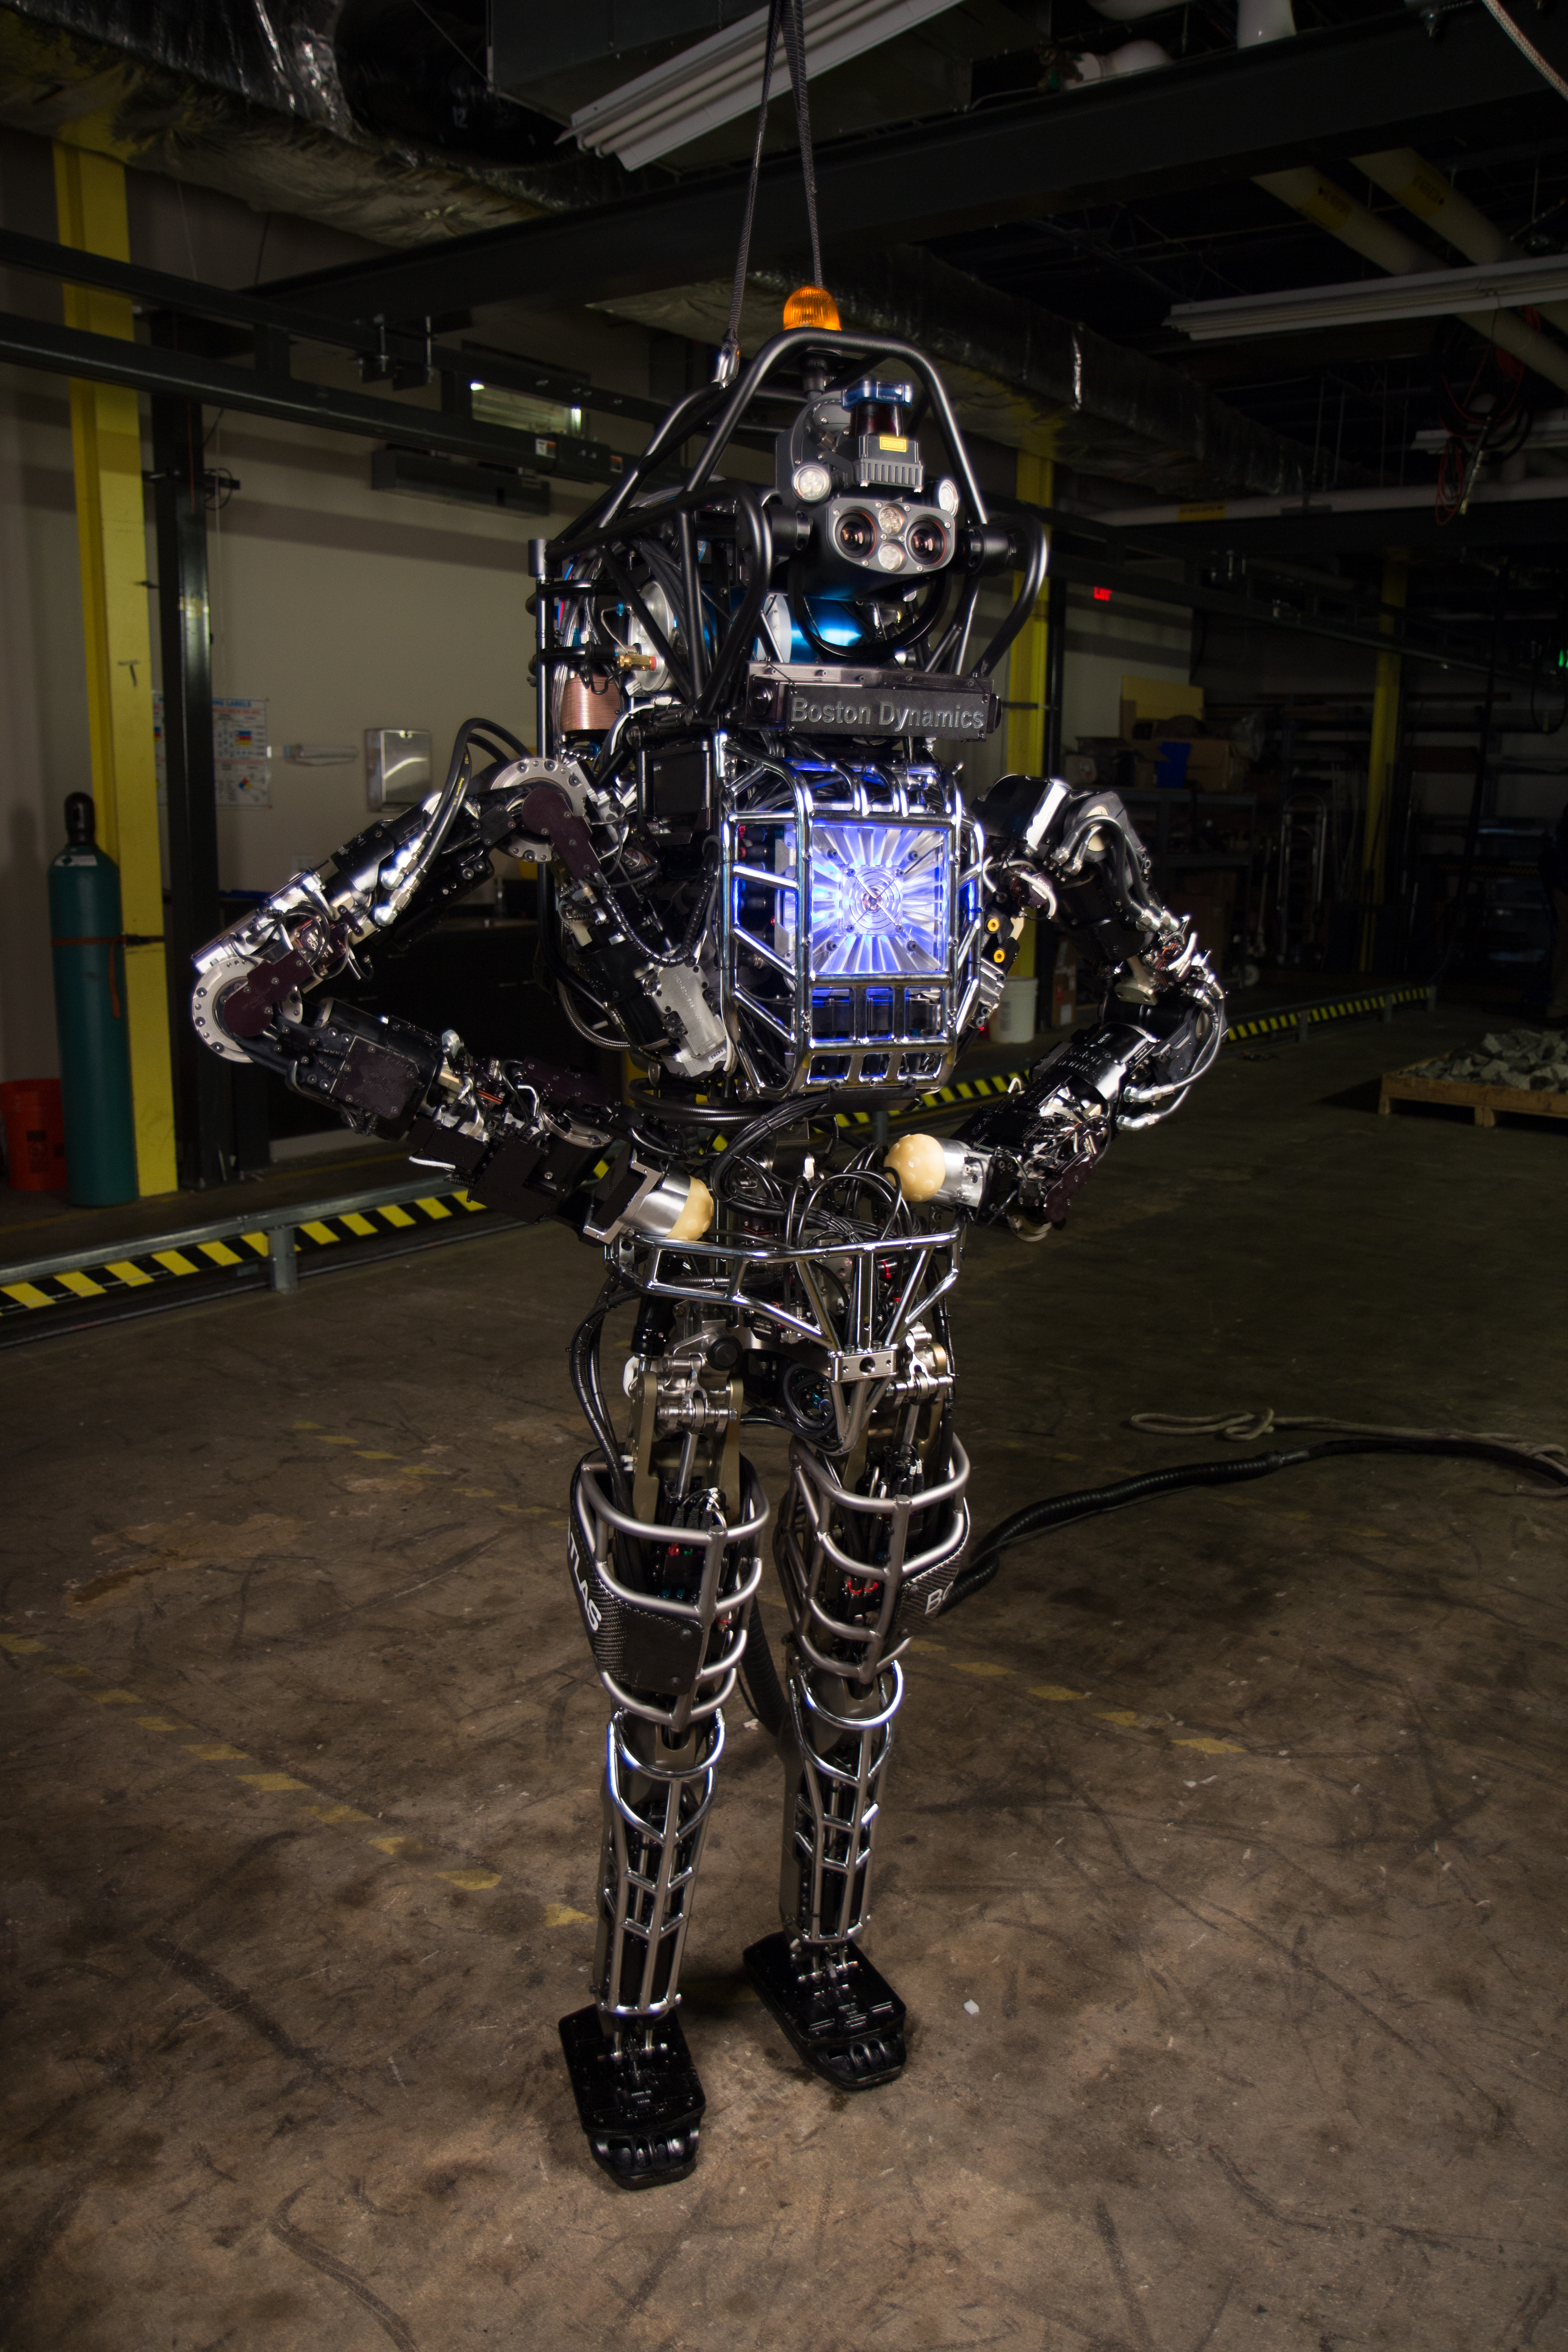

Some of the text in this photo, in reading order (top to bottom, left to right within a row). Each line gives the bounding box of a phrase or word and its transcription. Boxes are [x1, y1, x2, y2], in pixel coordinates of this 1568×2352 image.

[791, 697, 984, 732] Boston Dynamics
[710, 1049, 724, 1059] 14292
[755, 1317, 770, 1325] MOOG
[568, 1516, 602, 1632] TLAS
